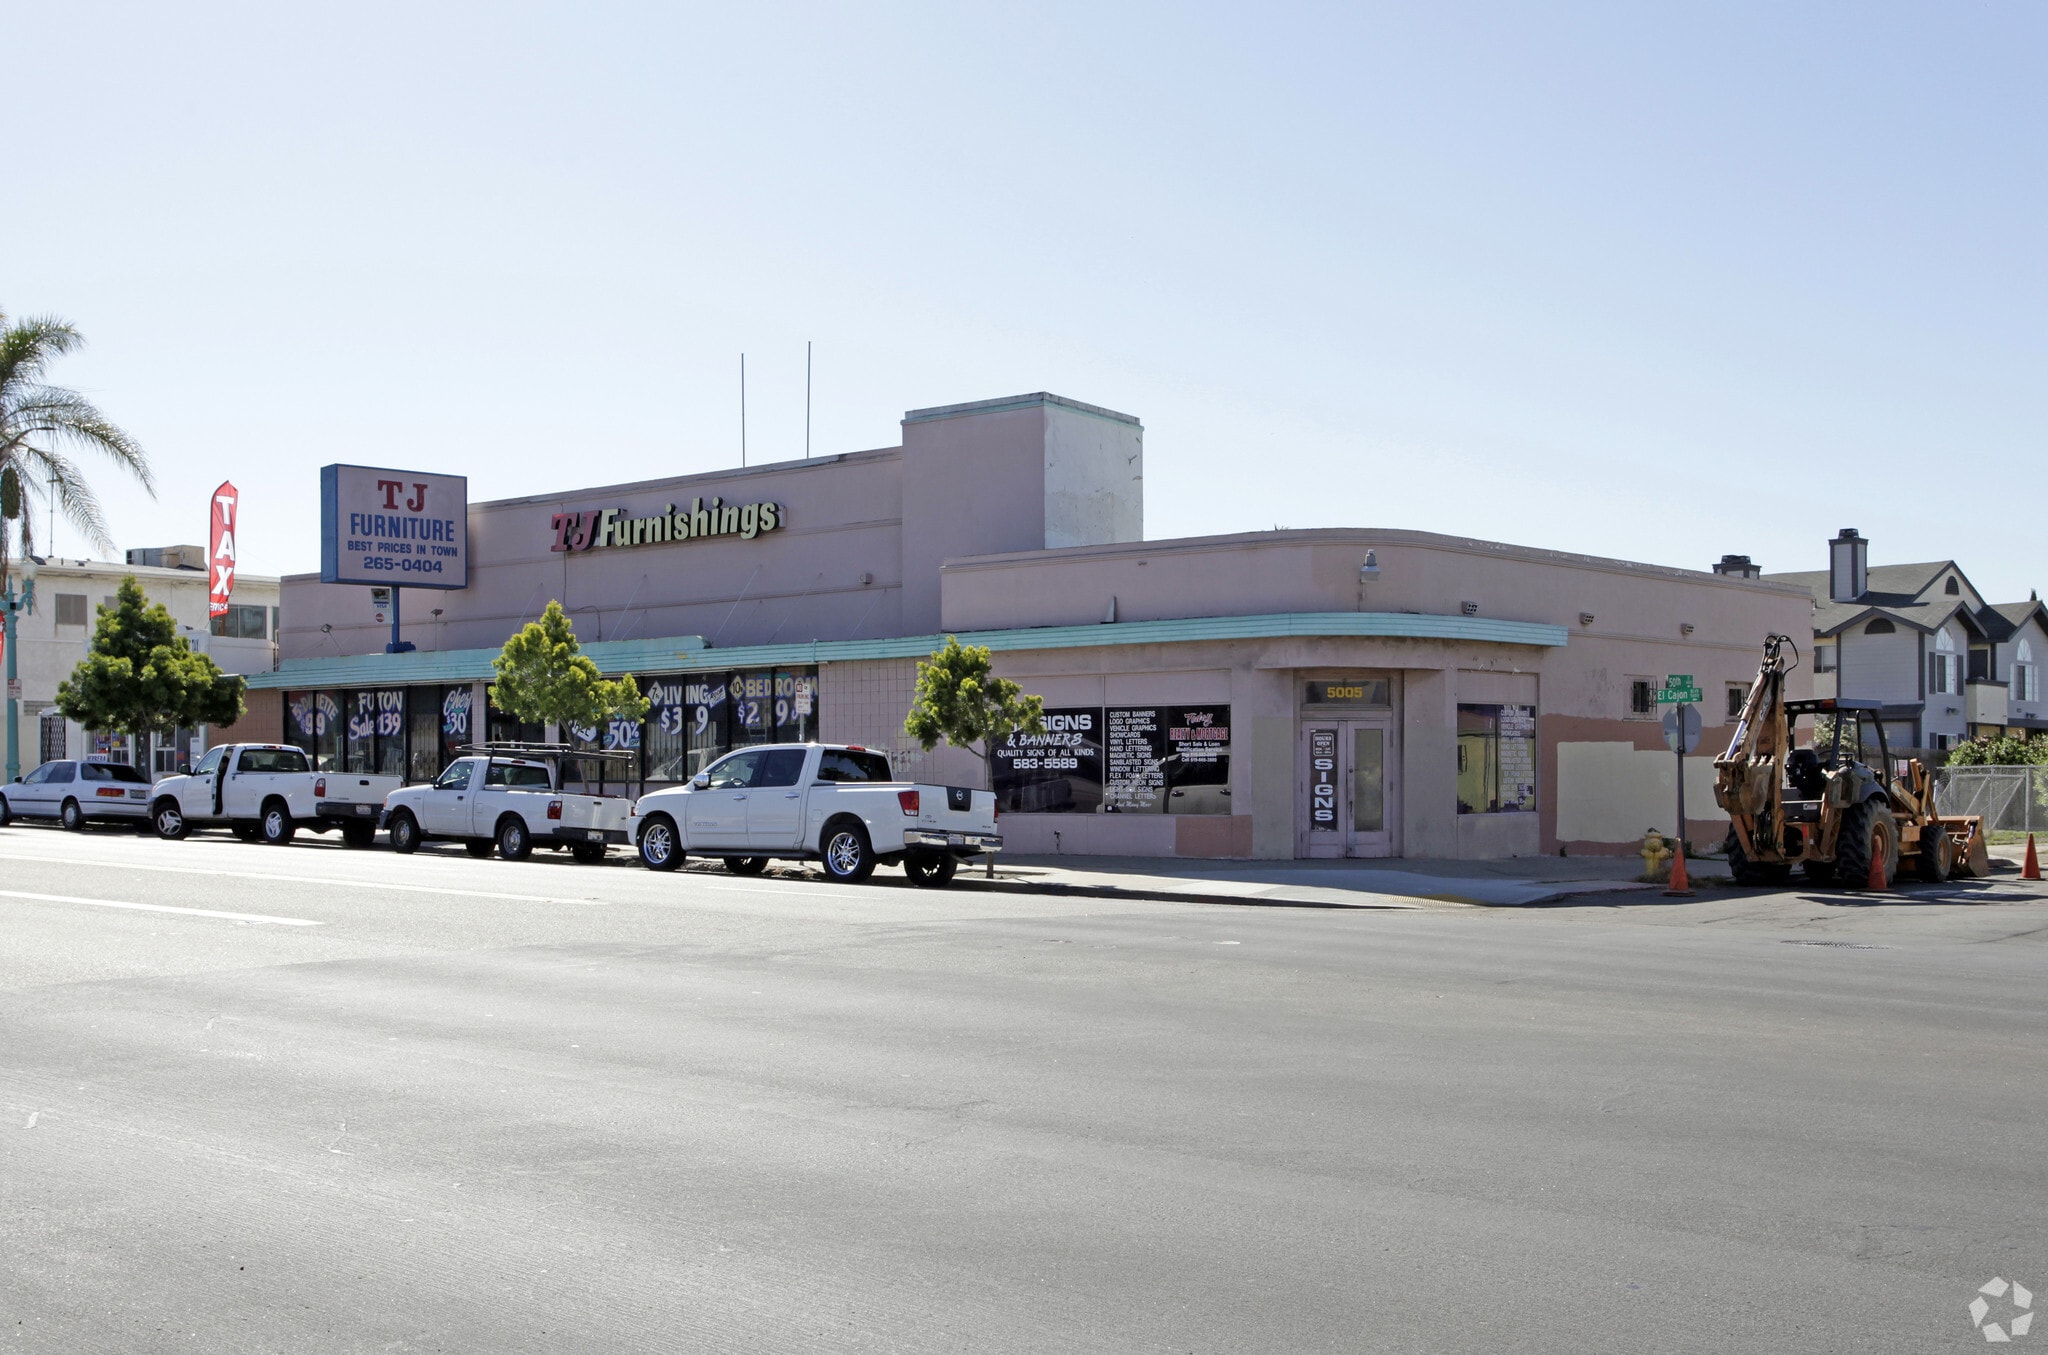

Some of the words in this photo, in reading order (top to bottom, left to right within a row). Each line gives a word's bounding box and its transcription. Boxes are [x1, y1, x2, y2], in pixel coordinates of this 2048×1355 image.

[377, 480, 428, 512] TJ
[350, 513, 455, 542] FURNITURE
[551, 510, 602, 552] TJ
[600, 497, 778, 547] Furnishings
[211, 495, 236, 596] TAX
[347, 540, 373, 552] BEST
[377, 542, 412, 554] PRICES
[416, 545, 426, 555] IN
[431, 546, 458, 557] TOWN
[363, 556, 443, 573] 265-0404
[663, 684, 709, 705] LIVING
[1327, 687, 1363, 698] 5005
[1657, 690, 1665, 700] El
[1668, 690, 1688, 702] Cajon
[358, 691, 403, 715] FUTON
[1132, 710, 1156, 718] BANNERS
[350, 713, 375, 740] Sale
[1125, 717, 1151, 725] GRAPHICS
[608, 721, 640, 750] 50%
[1109, 731, 1141, 739] SHOWCARDS
[1196, 726, 1229, 741] MORTGAGE
[1007, 733, 1017, 748] &
[1019, 733, 1083, 748] BANNERS
[997, 749, 1024, 758] QUALITY
[1027, 749, 1045, 757] SIGNS
[1048, 749, 1057, 757] OF
[1060, 749, 1071, 757] ALL
[1074, 748, 1095, 757] KINDS
[1125, 744, 1153, 752] LETTERING
[1136, 751, 1152, 759] SIGNS
[1013, 758, 1078, 769] 583-5589
[1143, 758, 1159, 766] SIGNS
[1109, 765, 1131, 773] WINDOW
[1132, 765, 1160, 773] LETTERING
[1137, 785, 1154, 793] SIGNS
[1314, 758, 1334, 822] SIGNS
[1134, 792, 1157, 800] LETTERS
